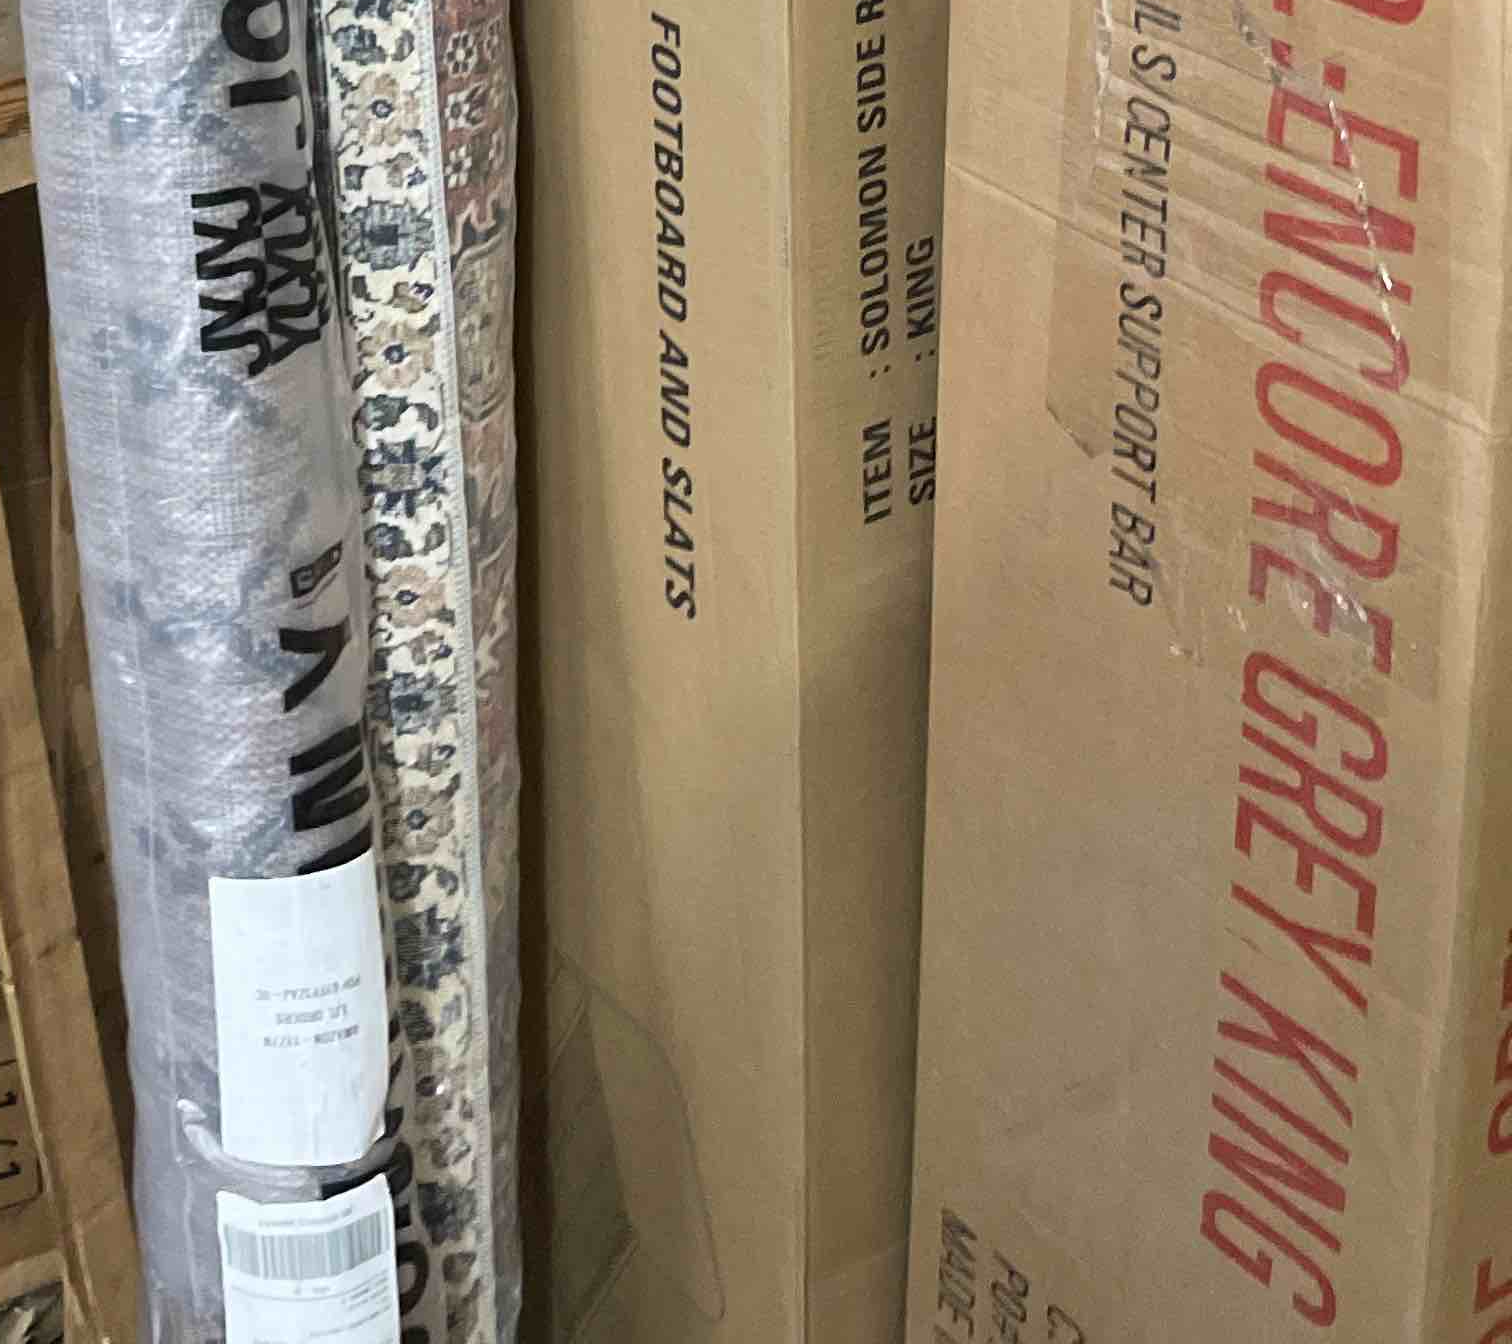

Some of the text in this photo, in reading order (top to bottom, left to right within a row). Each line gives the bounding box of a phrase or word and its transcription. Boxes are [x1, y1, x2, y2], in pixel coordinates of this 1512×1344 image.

[855, 33, 888, 135] SIDE
[650, 9, 688, 323] FOOTBOARD
[857, 142, 891, 357] SOLOMON
[906, 233, 937, 343] KING
[656, 329, 692, 449] AND
[1110, 279, 1164, 504] SUPPORT
[862, 416, 893, 527] ITEM
[908, 415, 938, 508] SIZE
[662, 456, 697, 620] SLATS
[1107, 500, 1157, 608] BAR
[1229, 650, 1388, 1016] GREY
[1198, 969, 1359, 1328] KING
[937, 1208, 978, 1339] MADE
